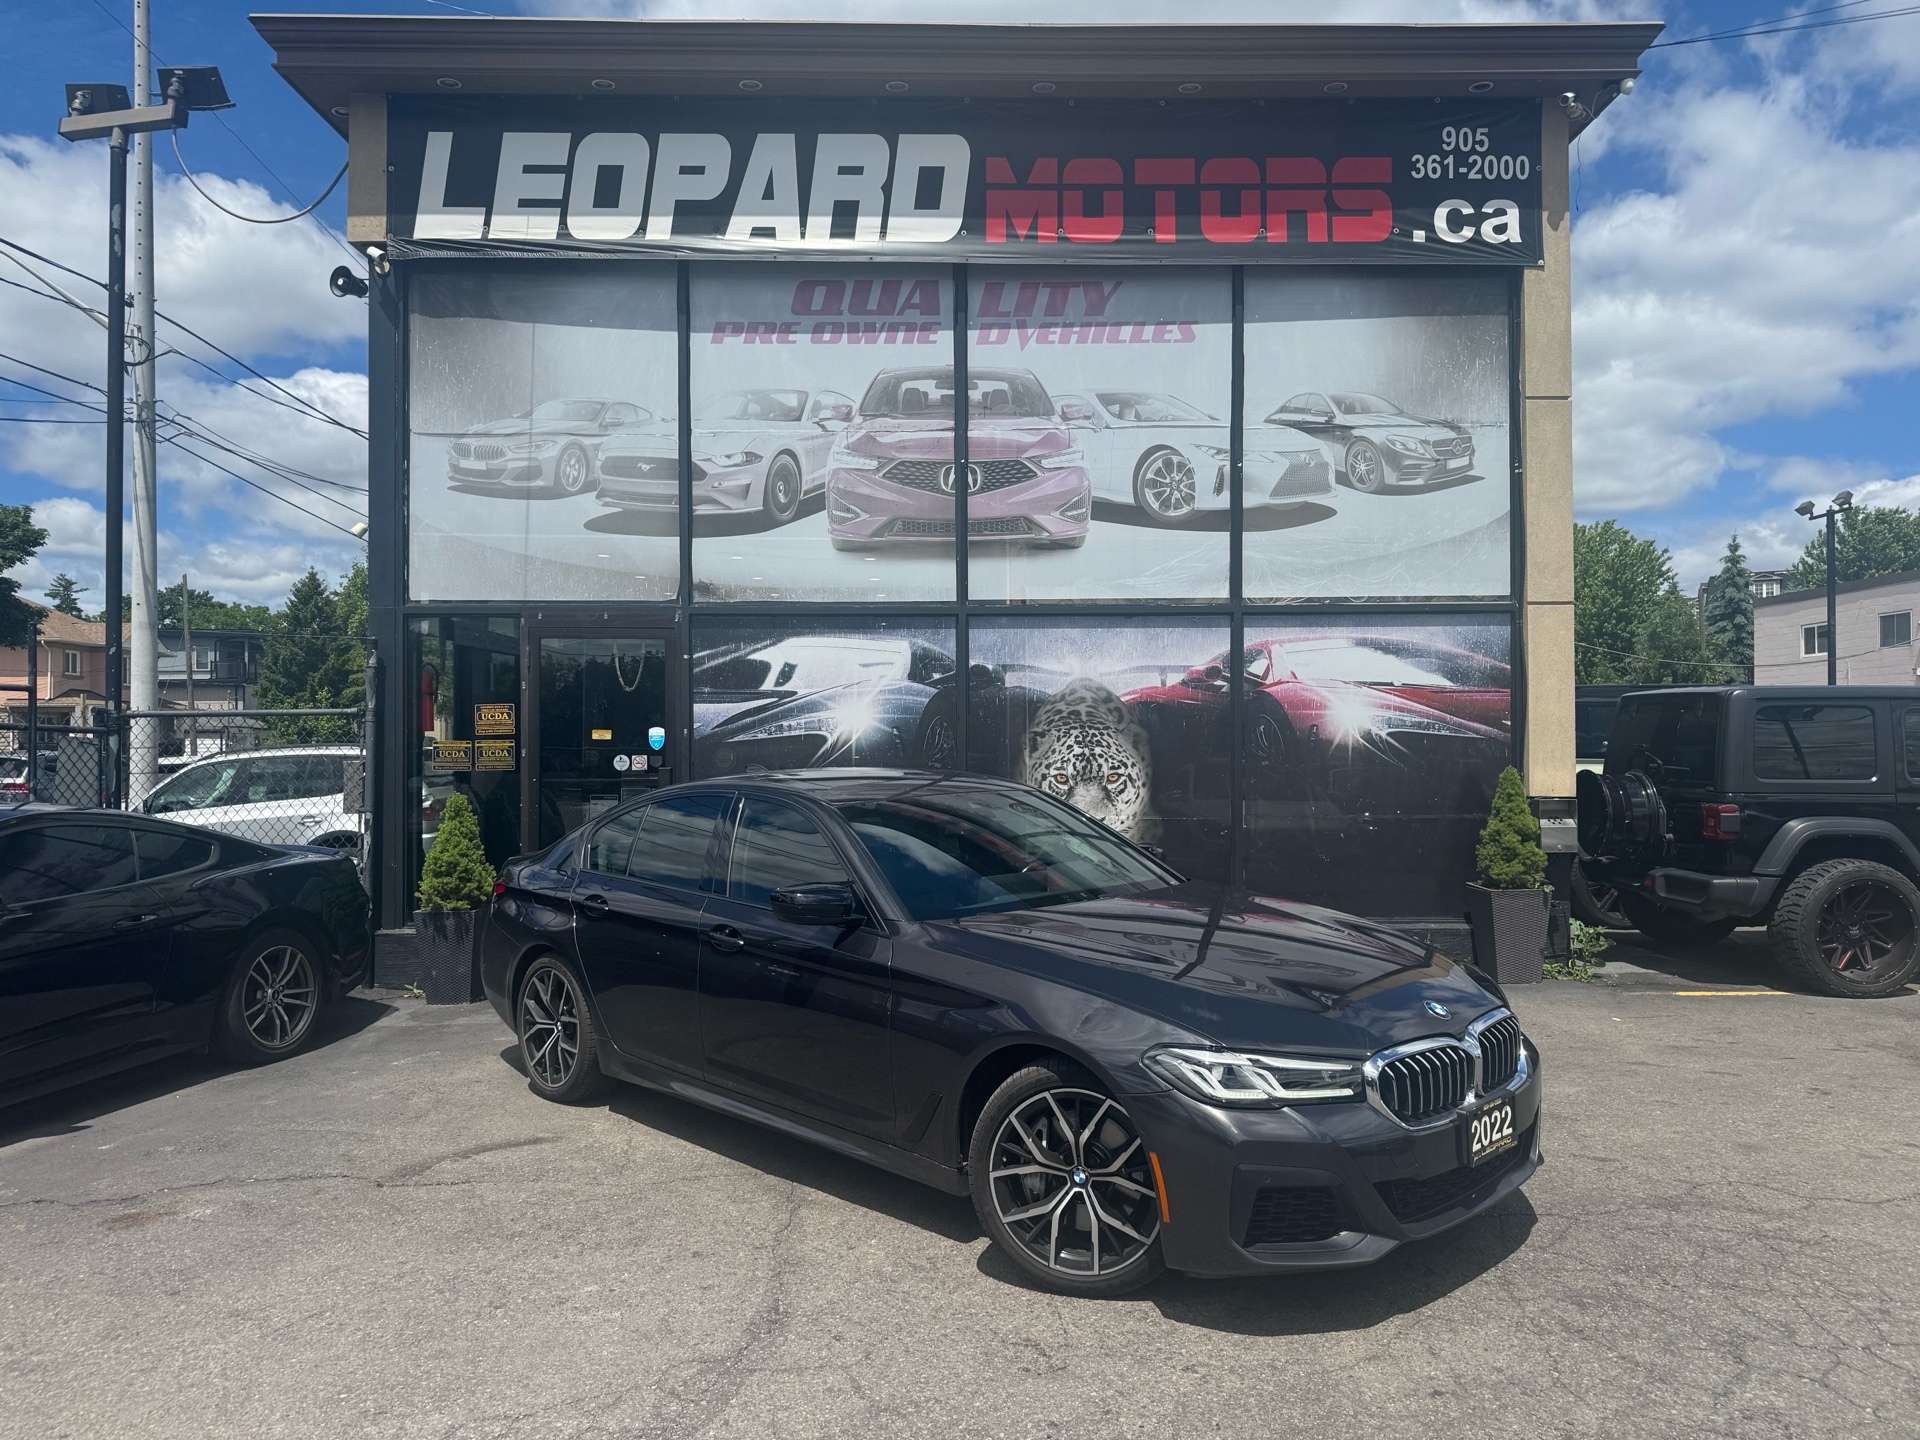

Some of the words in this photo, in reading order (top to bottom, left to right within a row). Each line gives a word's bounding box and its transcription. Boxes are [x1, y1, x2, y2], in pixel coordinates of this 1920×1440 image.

[1441, 126, 1490, 152] 905
[1410, 154, 1530, 180] 361-2000
[413, 131, 970, 243] LEOPARD
[984, 157, 1393, 243] MOTORS
[1412, 197, 1522, 243] .ca
[710, 320, 801, 345] PRE
[481, 712, 509, 720] UCDA
[439, 750, 466, 758] UCDA
[482, 749, 509, 757] UCDA
[1471, 1105, 1513, 1153] 2022
